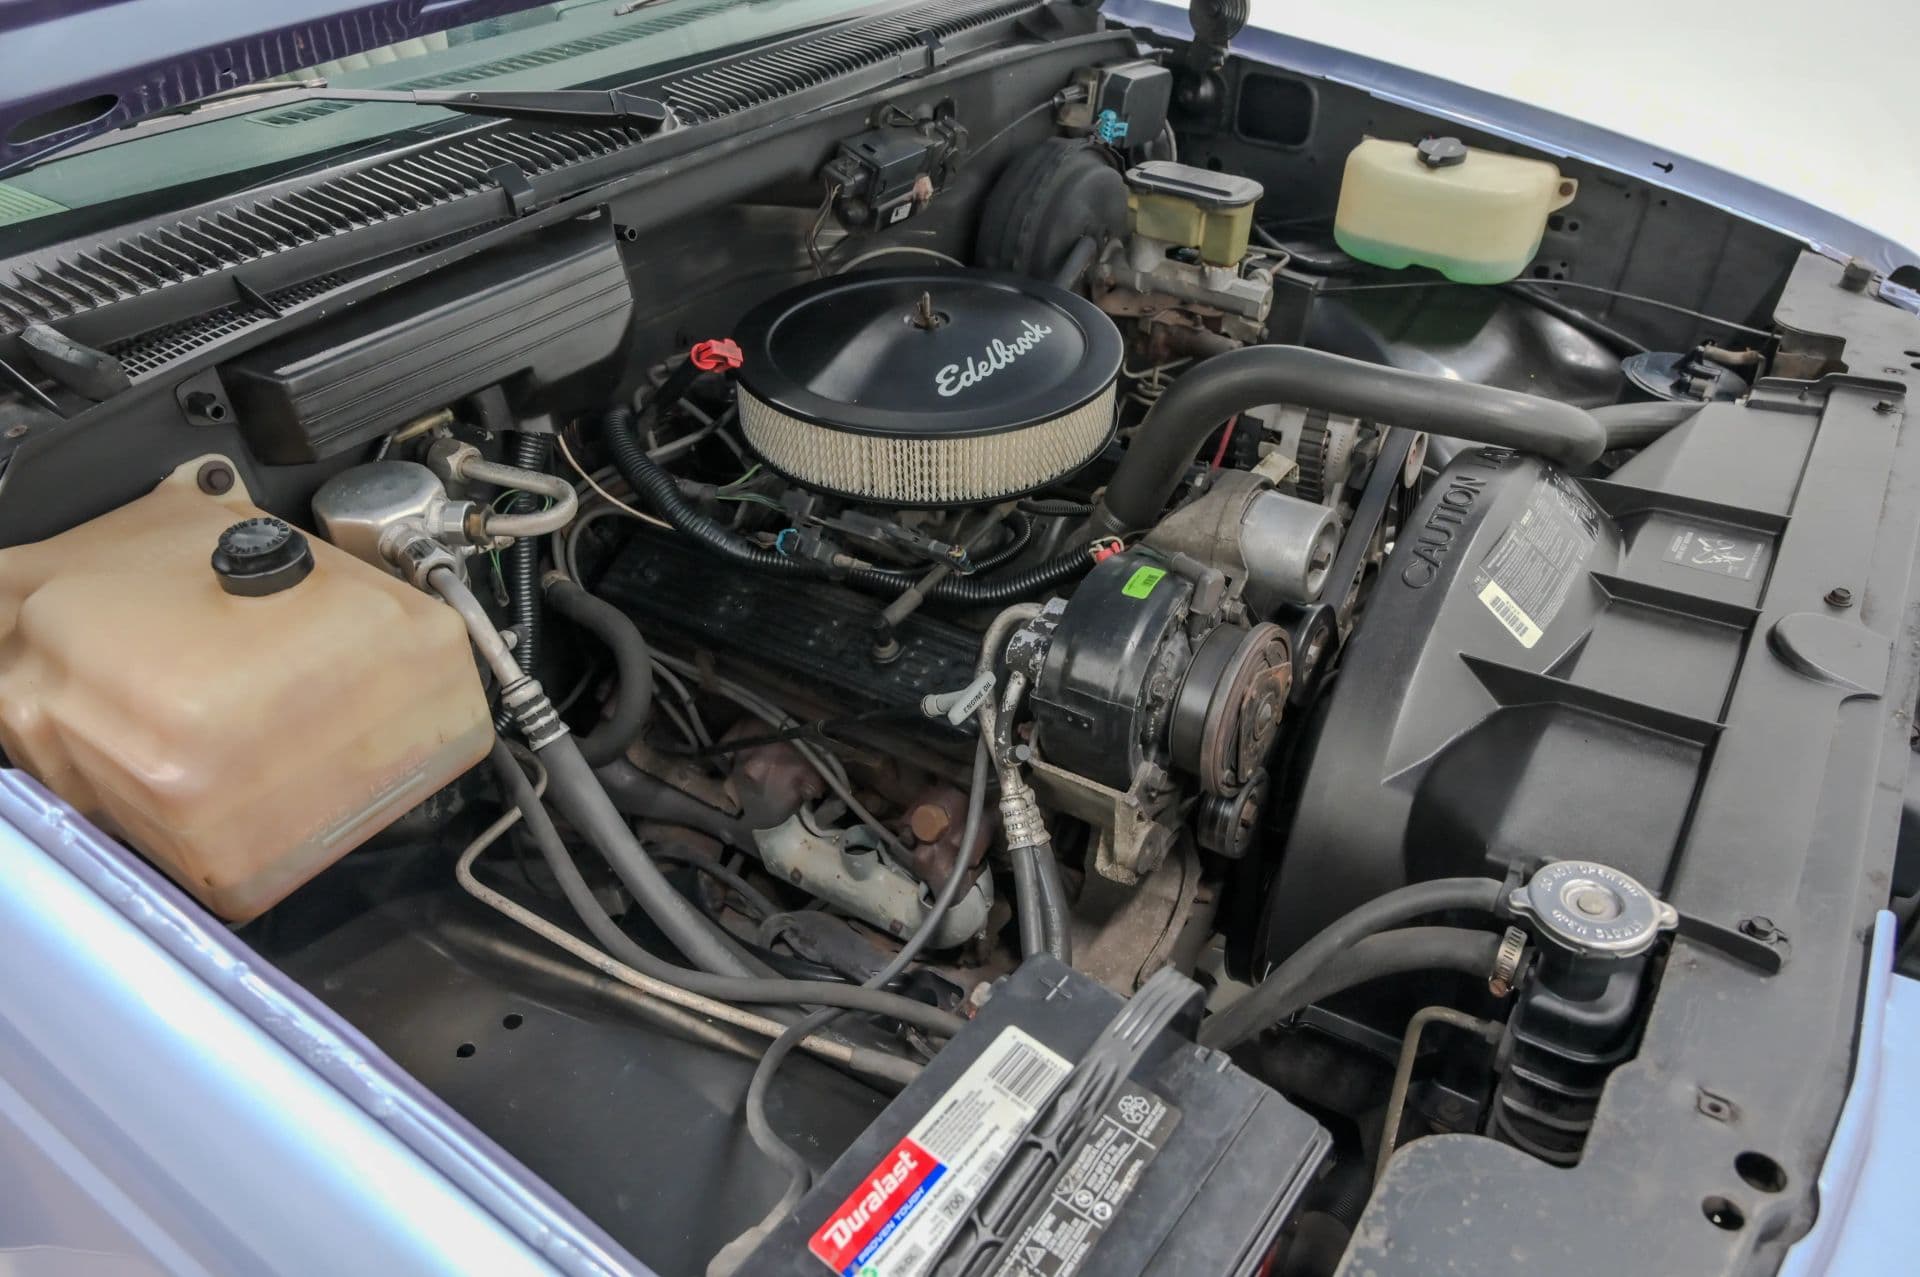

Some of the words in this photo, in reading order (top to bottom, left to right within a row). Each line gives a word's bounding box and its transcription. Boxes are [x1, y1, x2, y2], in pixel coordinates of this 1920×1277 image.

[935, 319, 1052, 397] Edelbrock
[1402, 475, 1487, 589] CAUTION
[963, 691, 984, 714] ENGINE
[983, 680, 992, 693] OIL
[822, 1149, 919, 1250] Duralast
[857, 1220, 896, 1263] PROVEN
[895, 1186, 926, 1222] TOUGH
[942, 1192, 966, 1216] 700
